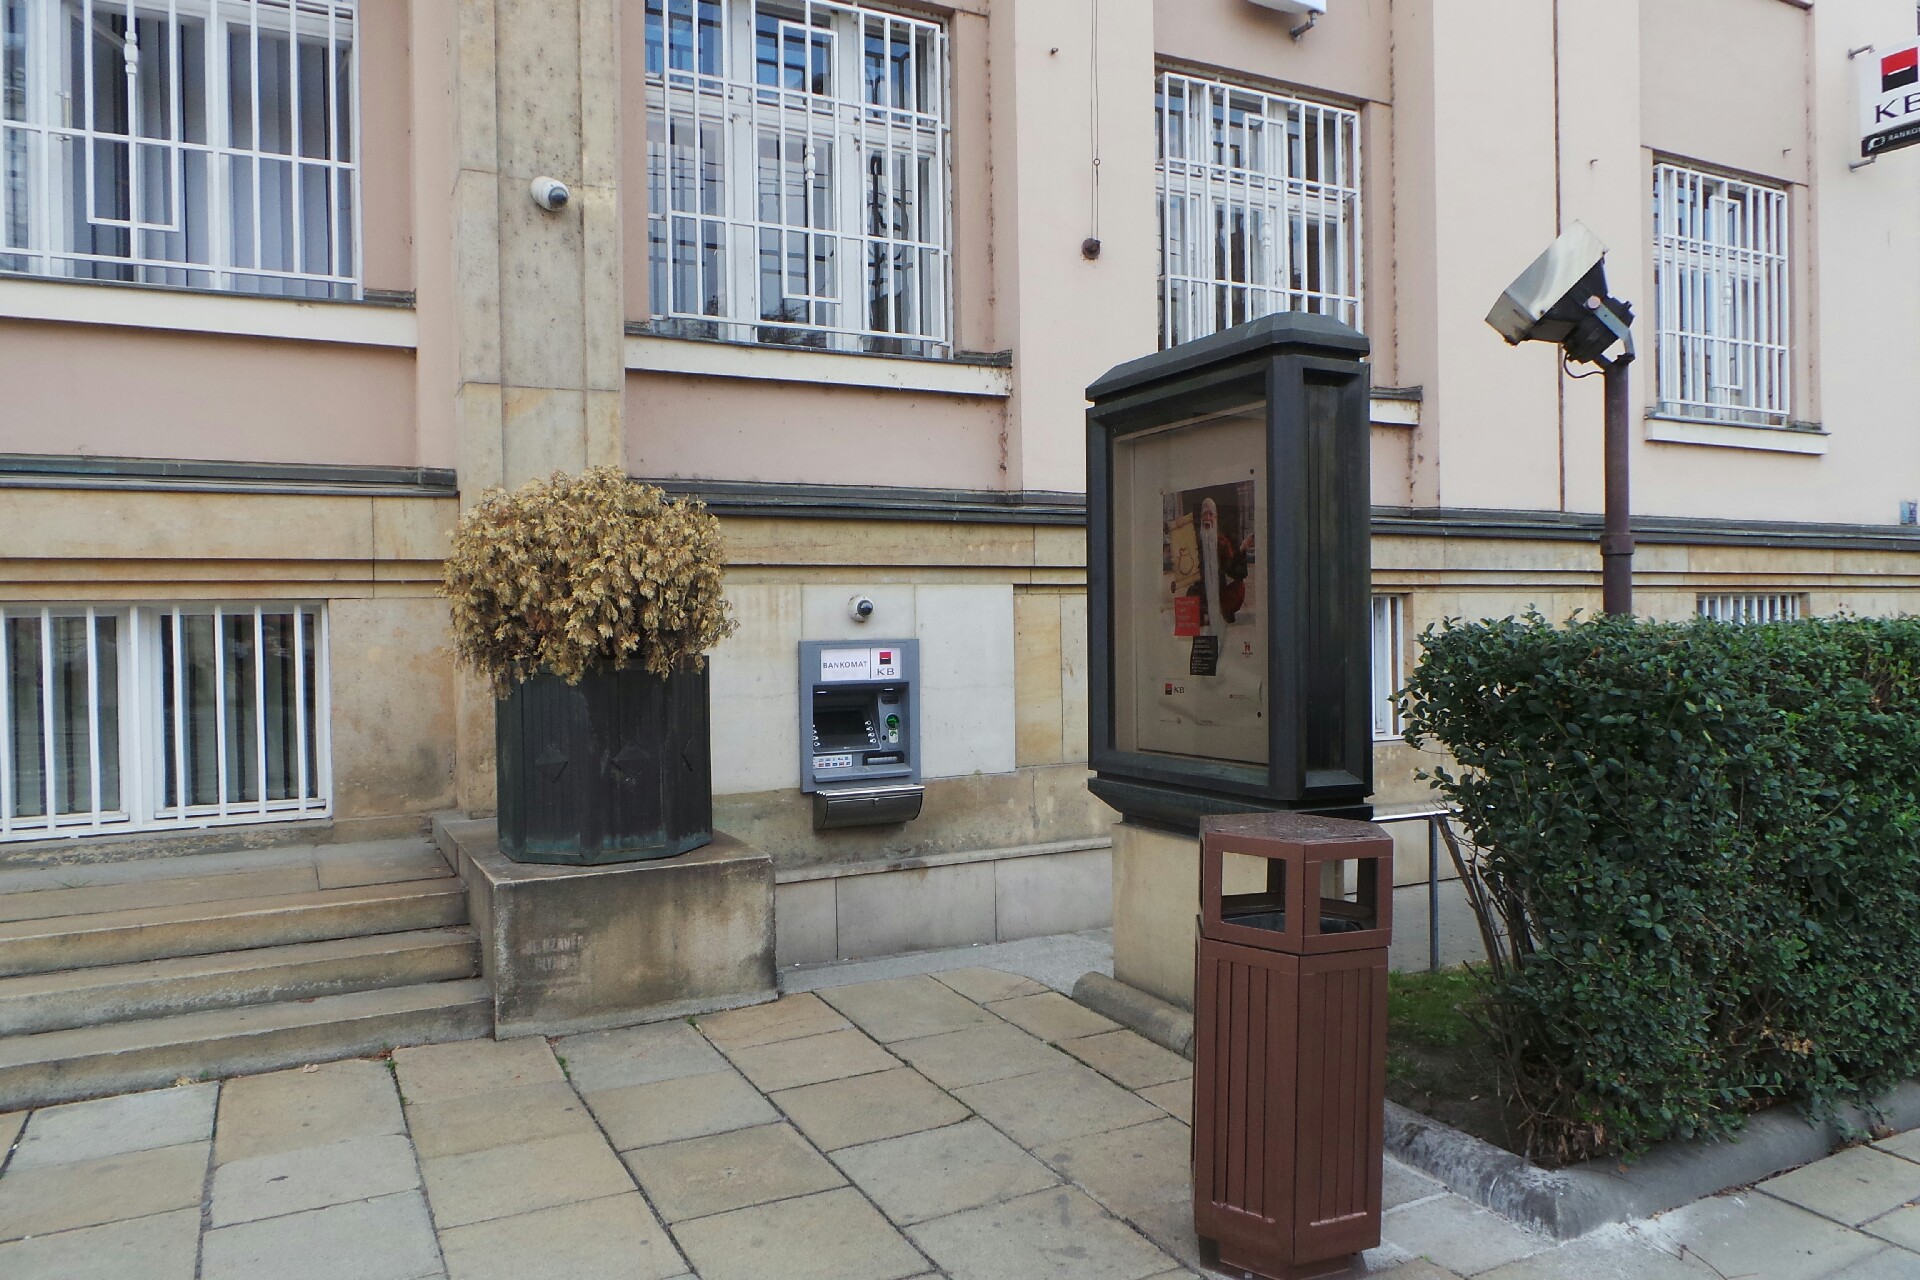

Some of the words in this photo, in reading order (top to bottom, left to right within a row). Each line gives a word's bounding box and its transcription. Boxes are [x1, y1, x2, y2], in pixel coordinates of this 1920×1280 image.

[1888, 127, 1920, 141] BANKO
[823, 661, 868, 669] BANKOMAT
[877, 668, 895, 676] KB
[1174, 686, 1185, 694] KB
